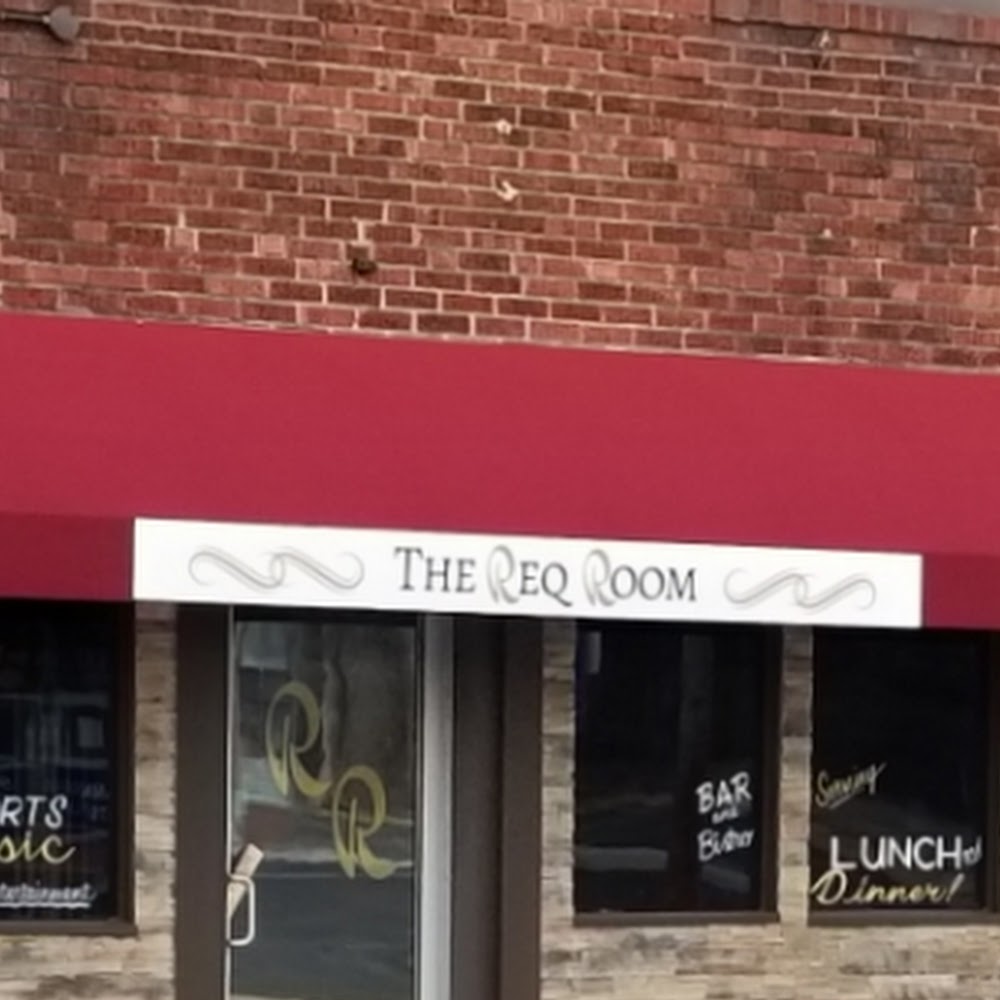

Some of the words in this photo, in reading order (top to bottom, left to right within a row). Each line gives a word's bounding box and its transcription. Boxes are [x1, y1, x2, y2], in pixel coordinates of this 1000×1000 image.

[394, 546, 476, 593] THE
[486, 544, 573, 607] REQ
[583, 548, 698, 607] ROOM
[0, 794, 69, 829] RTS
[695, 771, 752, 814] BAR
[829, 835, 963, 871] LUNCH
[808, 867, 966, 905] Dinner!
